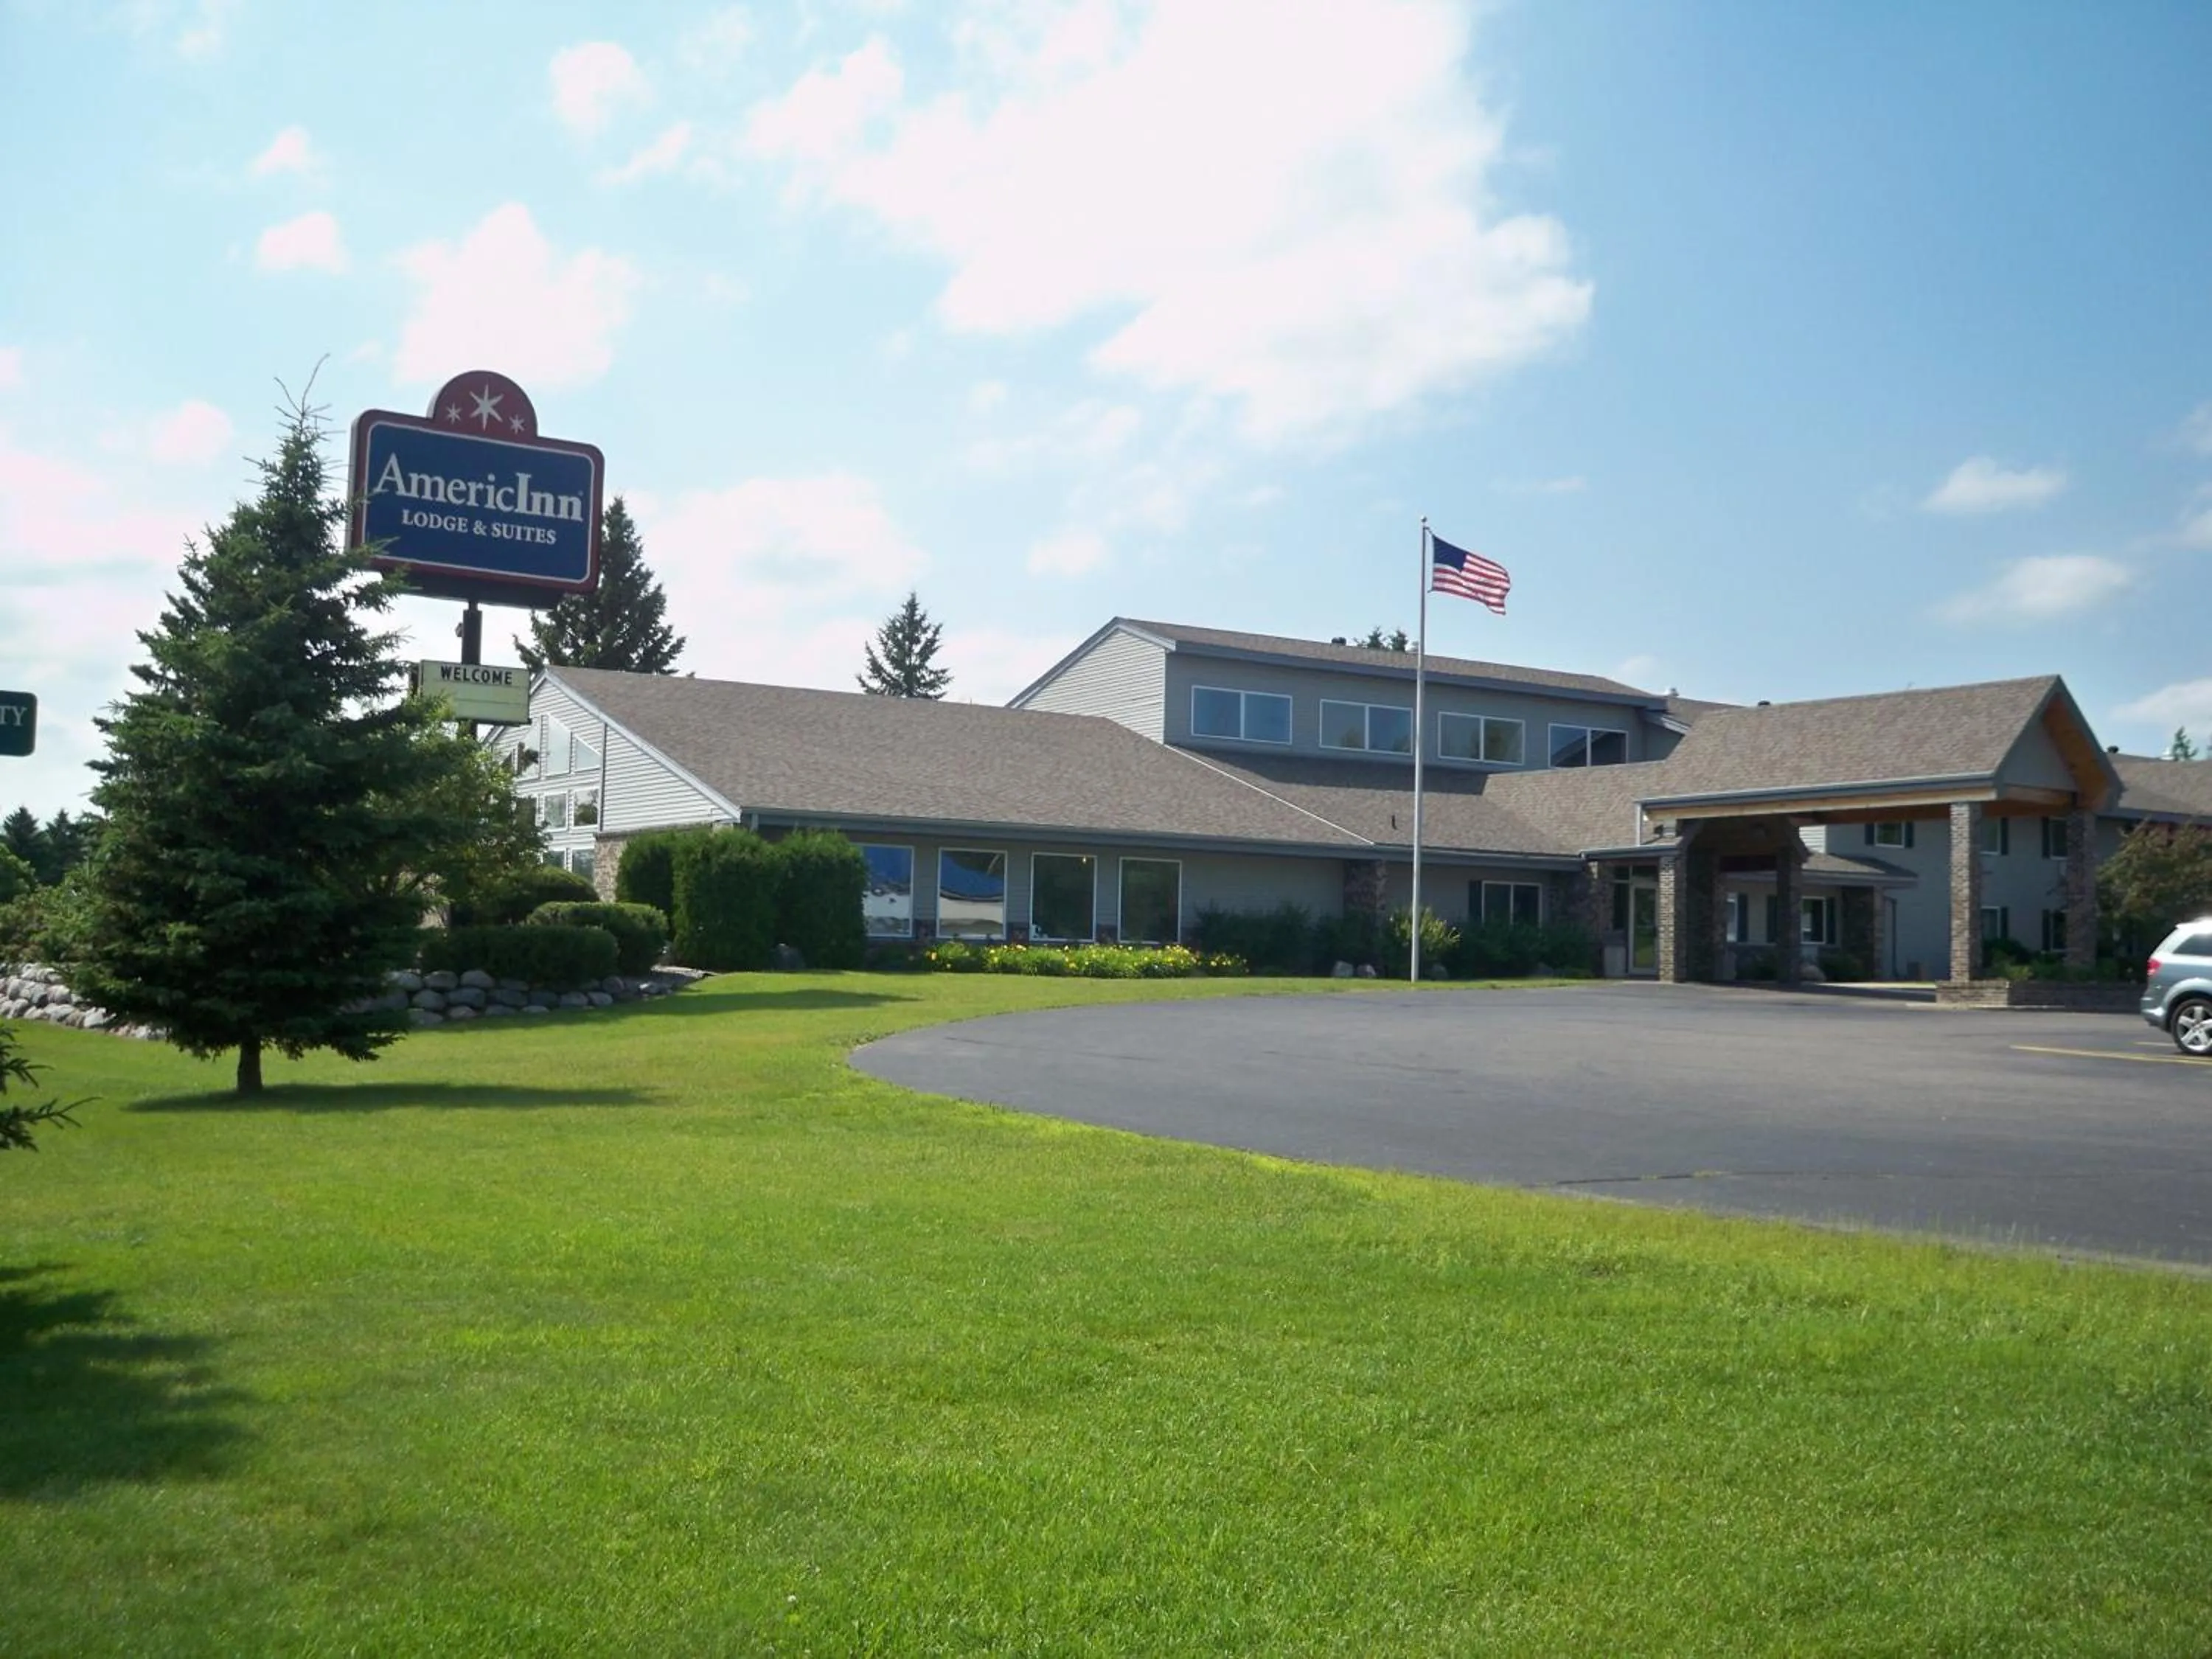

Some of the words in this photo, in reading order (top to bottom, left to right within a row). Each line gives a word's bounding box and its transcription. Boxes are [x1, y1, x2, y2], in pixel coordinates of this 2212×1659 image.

[373, 452, 583, 522] AmericInn
[402, 509, 468, 533] LODGE
[473, 519, 487, 536] &
[491, 522, 557, 544] SUITES
[440, 666, 512, 684] WELCOME
